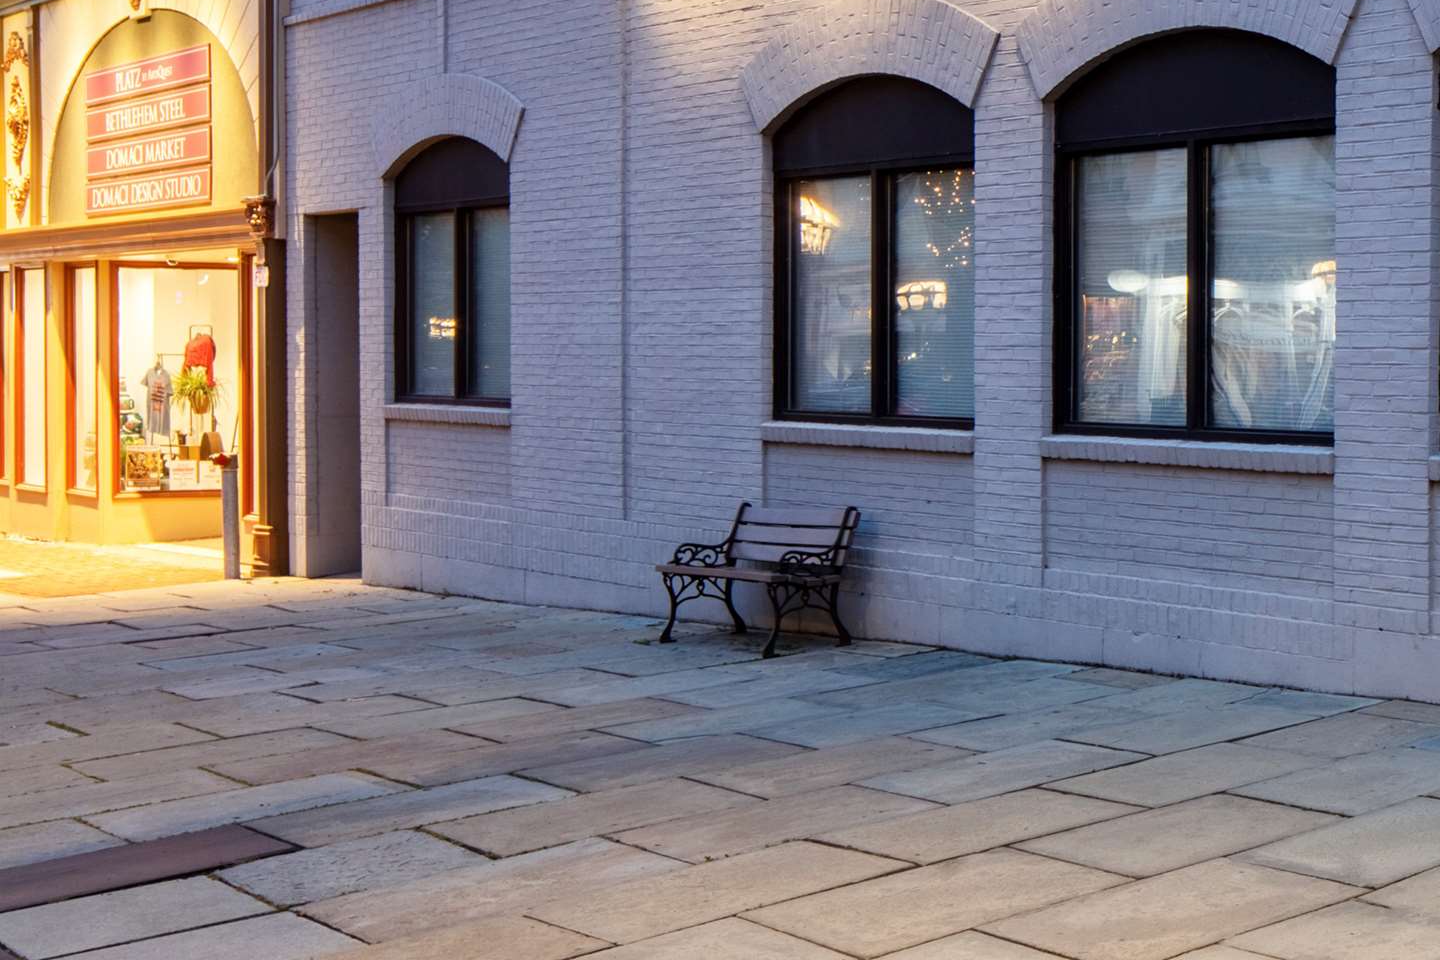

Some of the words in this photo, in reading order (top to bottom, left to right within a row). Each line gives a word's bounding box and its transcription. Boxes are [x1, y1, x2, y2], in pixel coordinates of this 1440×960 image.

[115, 68, 142, 92] PLATZ
[105, 103, 157, 132] BETHLEHEM
[159, 98, 185, 122] STEEL
[105, 144, 143, 169] DOMACI
[145, 137, 186, 162] MARKET
[92, 184, 128, 208] DOMACI
[131, 179, 163, 202] DESIGN
[165, 175, 201, 199] STUDIO
